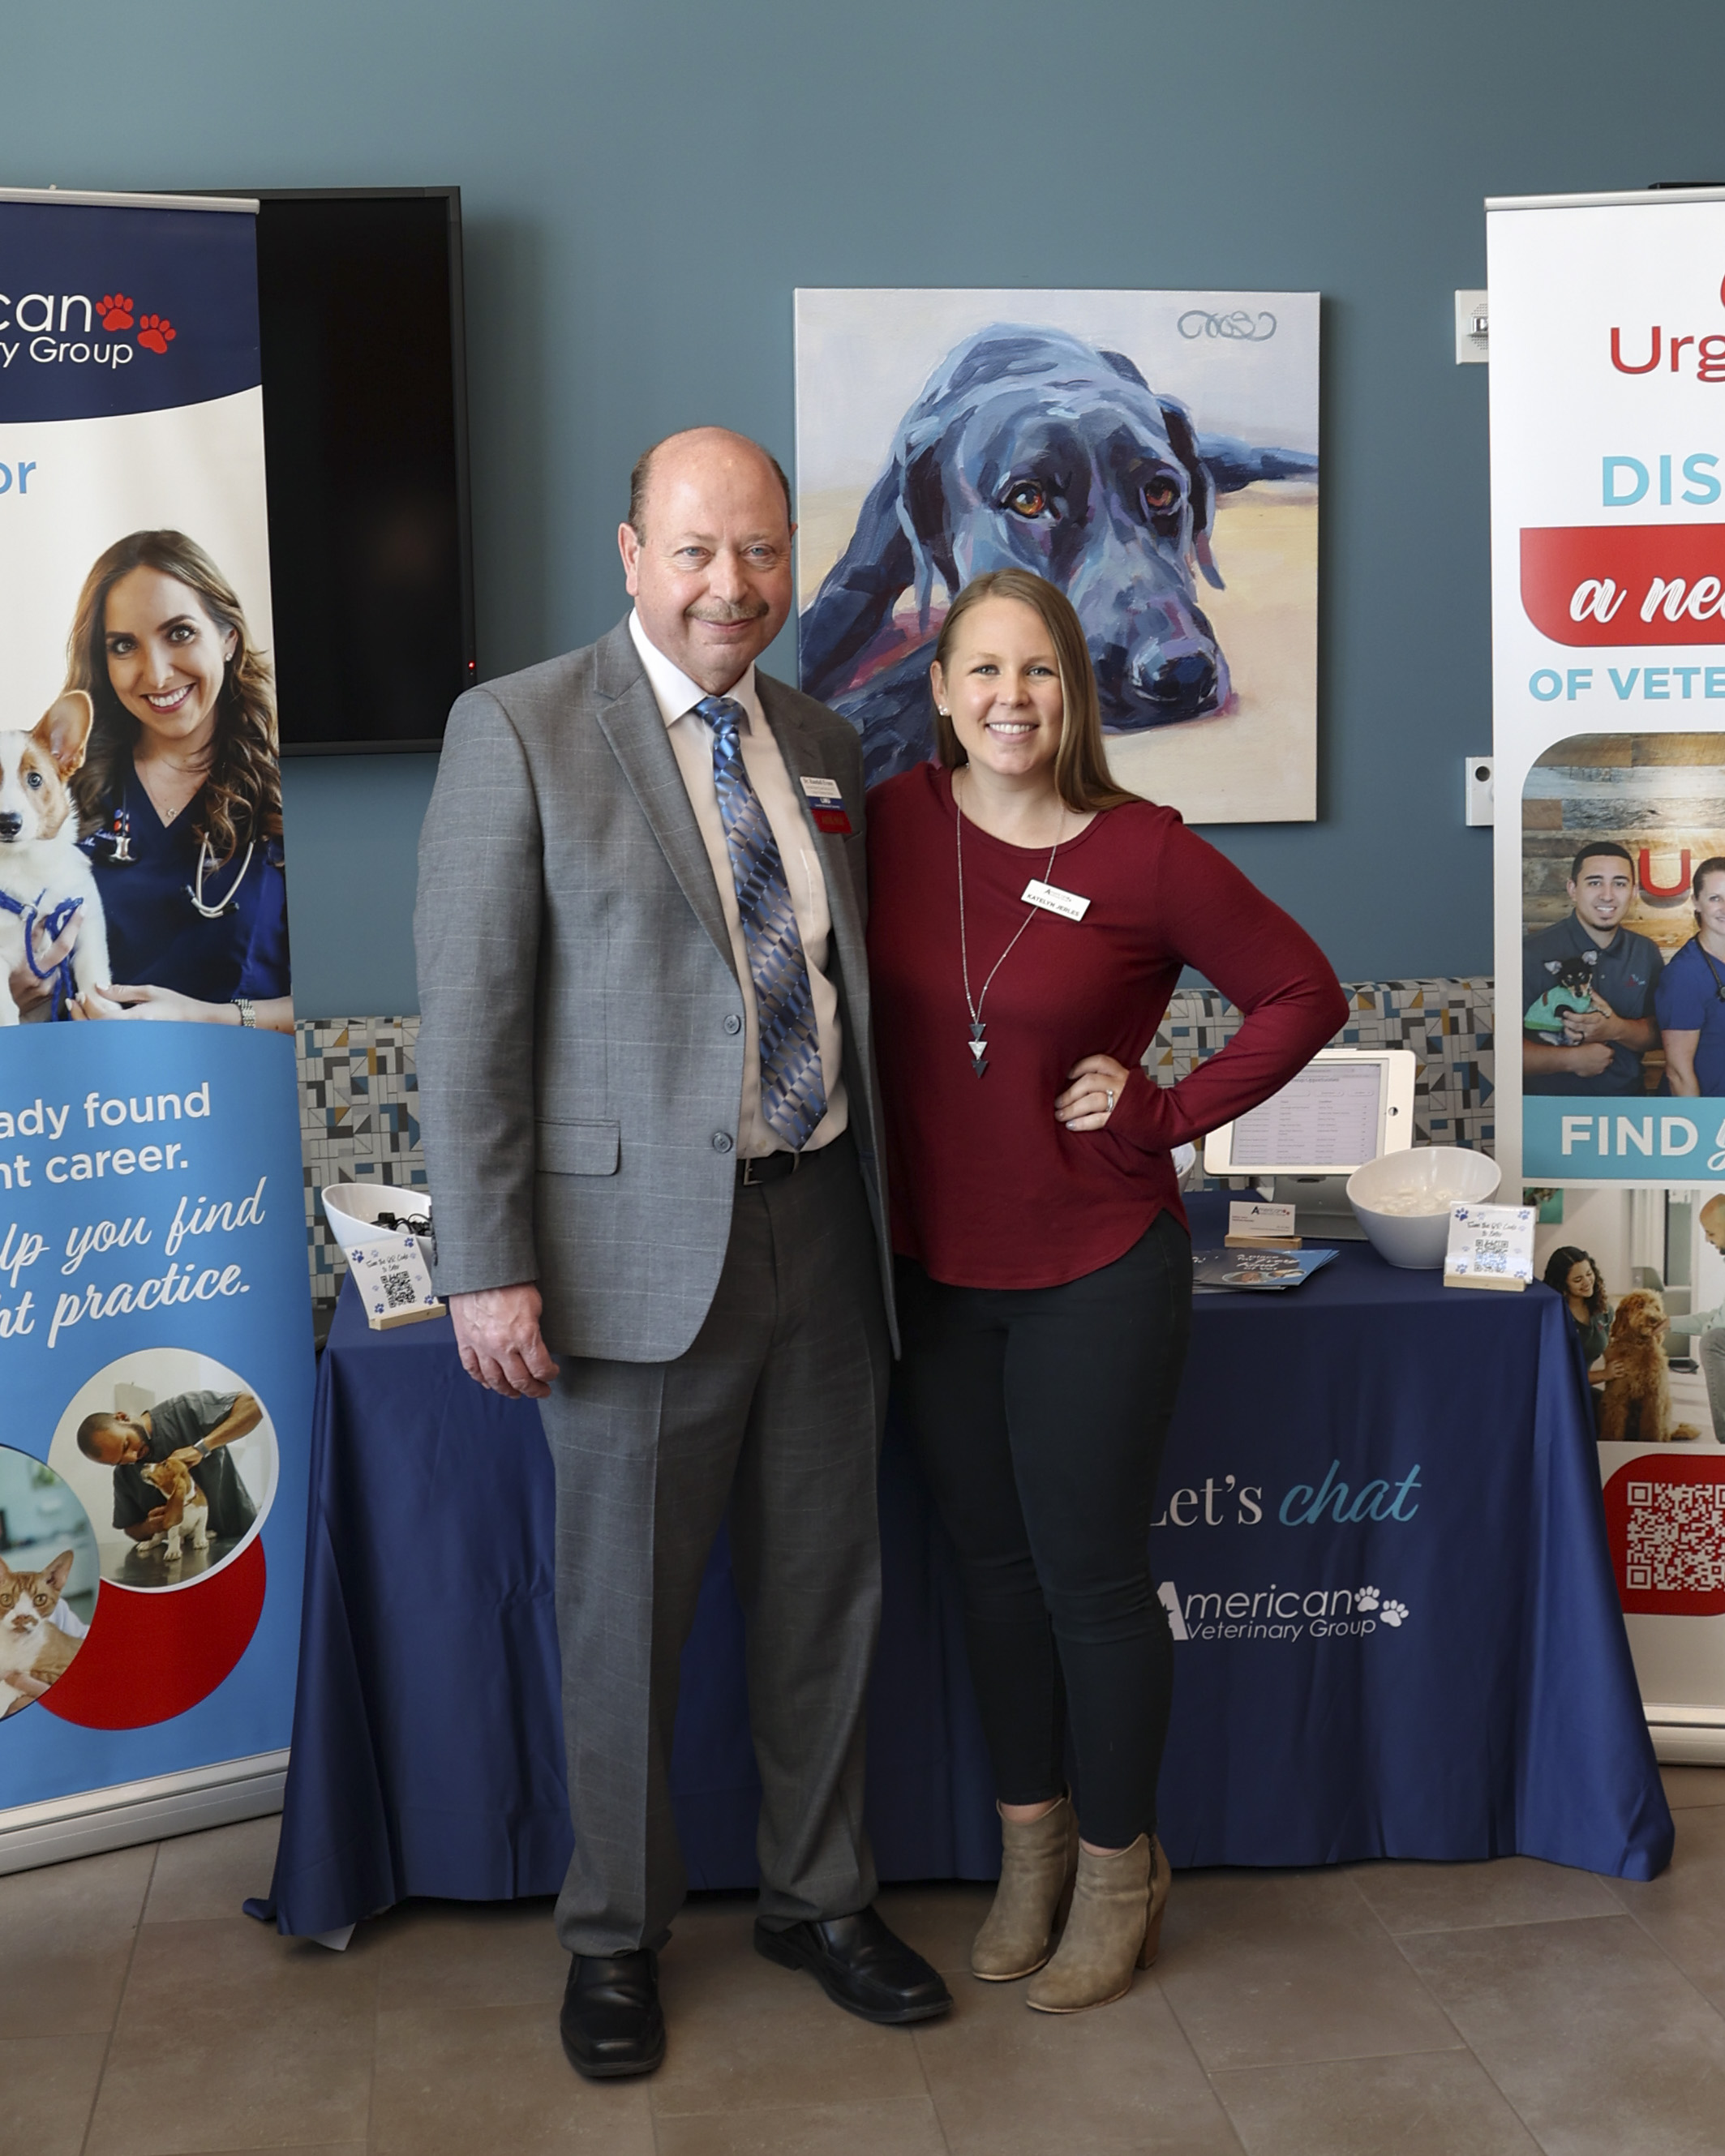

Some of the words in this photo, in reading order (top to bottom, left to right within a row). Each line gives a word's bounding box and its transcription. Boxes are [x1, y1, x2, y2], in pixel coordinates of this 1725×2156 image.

[29, 336, 134, 370] Group
[1610, 326, 1725, 383] Urg
[1603, 452, 1722, 508] DIS
[1569, 577, 1628, 624] a
[1639, 575, 1725, 624] ne
[1529, 668, 1593, 702] OF
[1607, 666, 1725, 701] VETE
[83, 1081, 211, 1129] found
[1561, 1115, 1699, 1157] FIND
[45, 1142, 189, 1184] career.
[61, 1215, 153, 1276] you
[165, 1175, 268, 1257] find
[47, 1262, 251, 1349] practice.
[1150, 1473, 1263, 1527] et's
[1278, 1459, 1422, 1527] chat
[1187, 1621, 1303, 1643] Veterinary
[1308, 1618, 1377, 1638] Group
